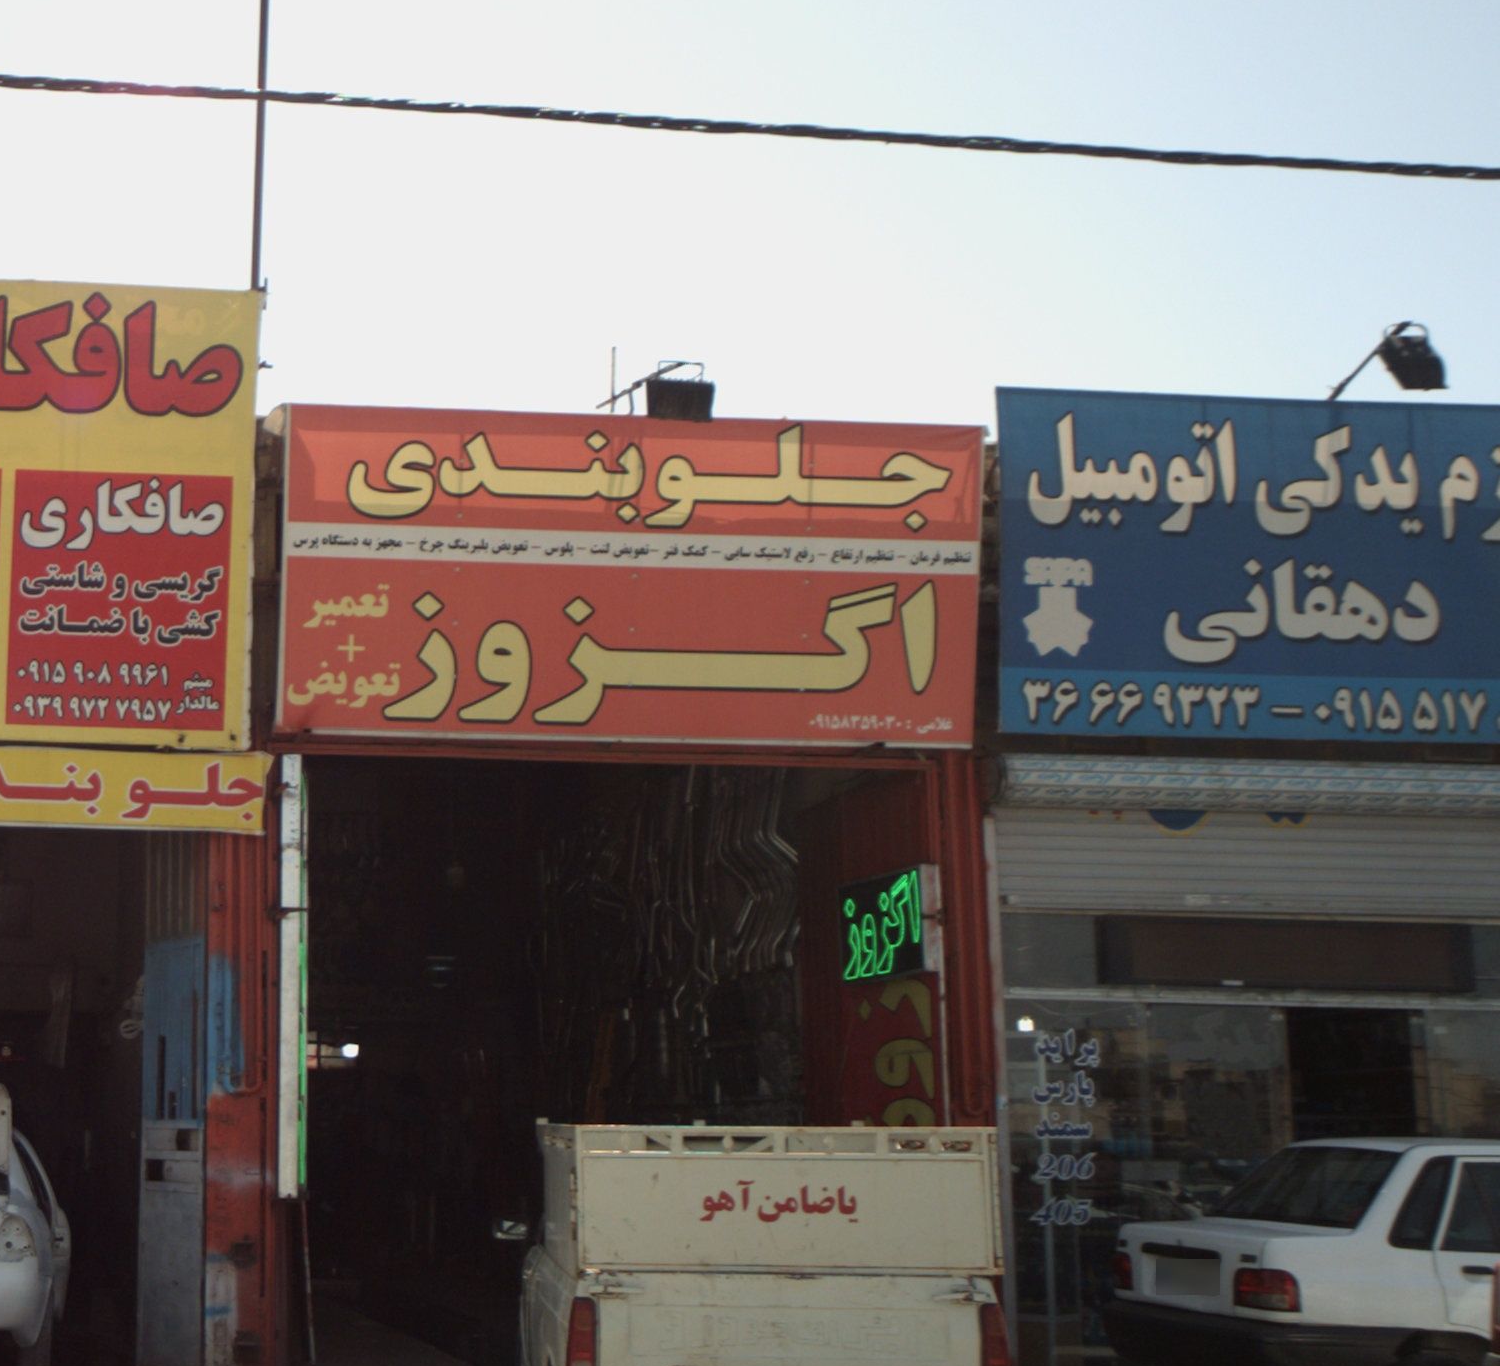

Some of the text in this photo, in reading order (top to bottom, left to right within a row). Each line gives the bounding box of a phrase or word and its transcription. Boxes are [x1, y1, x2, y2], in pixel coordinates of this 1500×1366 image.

[1027, 411, 1237, 532] اتومبیل
[1255, 424, 1425, 537] یدکی
[19, 477, 225, 550] صافکاری
[943, 550, 972, 565] تنظیم
[20, 560, 106, 597] شاستی
[109, 573, 128, 600] و
[18, 605, 221, 645] کشی با ضمانت
[301, 583, 390, 628] تعمیر
[1164, 557, 1441, 664] دهقانی
[381, 579, 937, 725] اگزوز
[17, 658, 169, 687] ۰۹۱۵ ۹۰۸ ۹۹۶۱
[286, 659, 402, 708] تعویض
[13, 694, 64, 718] ۰۹۳۹
[69, 696, 110, 719] ۹۷۲
[115, 697, 172, 723] ۷۹۵۷
[1152, 682, 1261, 728] ۹۳۲۳
[1314, 686, 1404, 732] ۰۹۱۵
[1035, 1028, 1100, 1067] پراید
[1033, 1069, 1096, 1107] پارس
[1035, 1112, 1093, 1139] سمند
[1034, 1152, 1097, 1181] 206
[699, 1180, 755, 1223] آهو
[1029, 1197, 1094, 1226] 405
